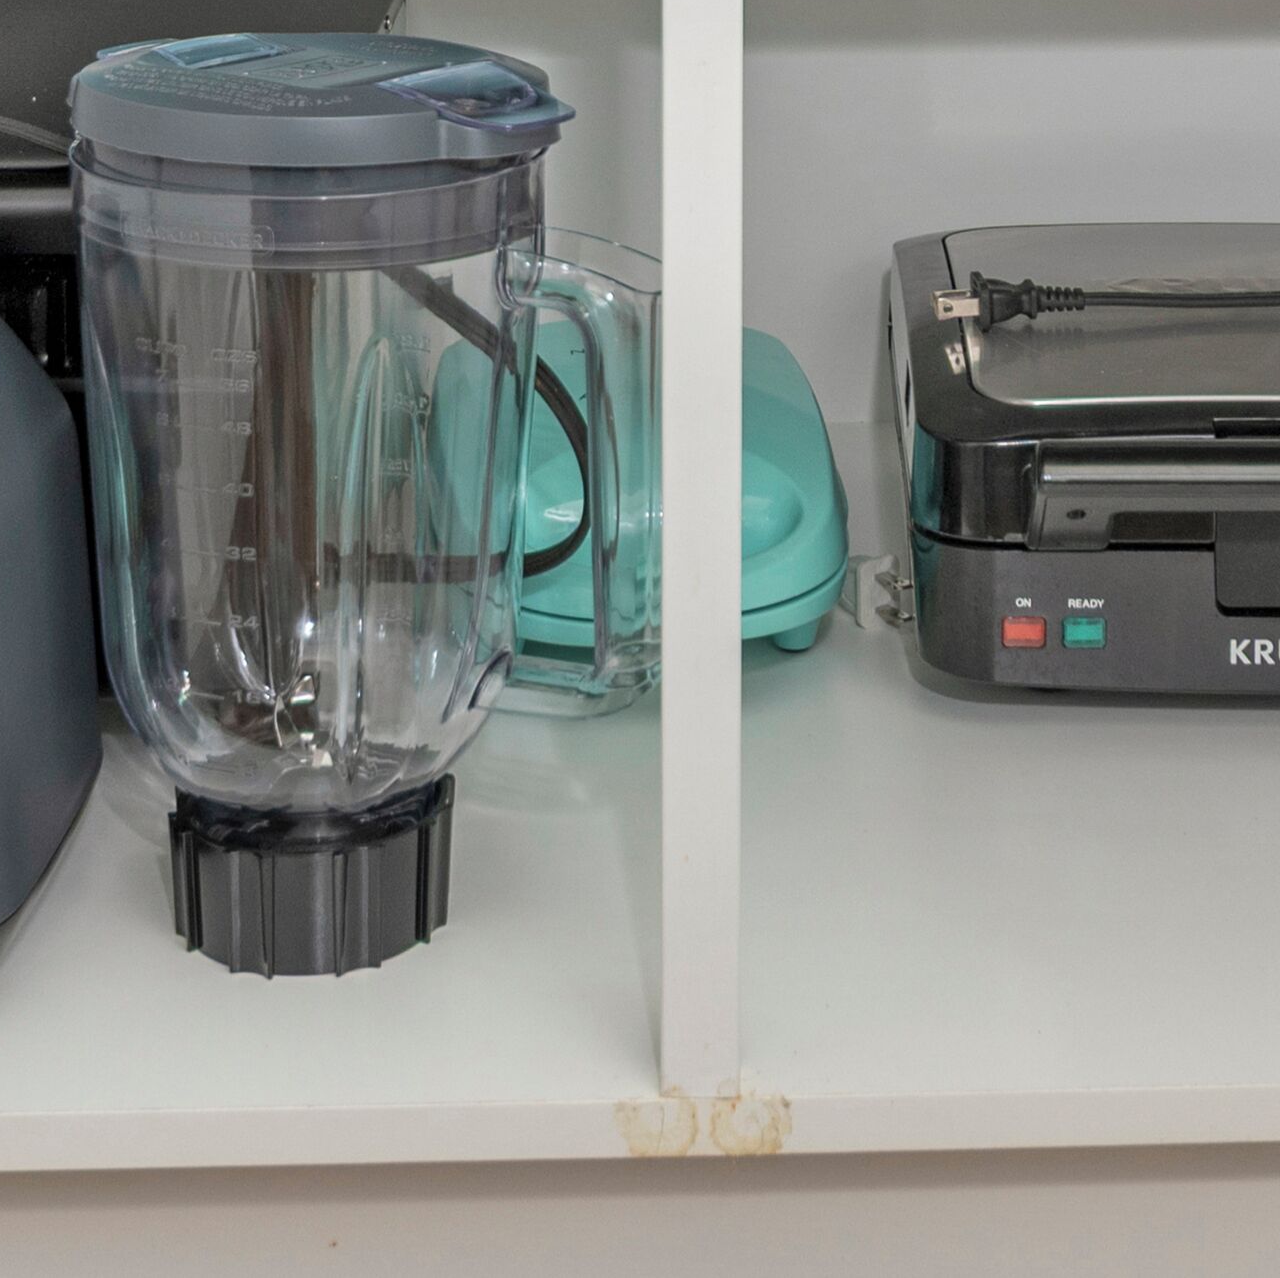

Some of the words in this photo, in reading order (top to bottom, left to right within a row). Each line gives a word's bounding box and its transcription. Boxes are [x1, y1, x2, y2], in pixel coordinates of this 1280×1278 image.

[224, 546, 258, 562] 32
[1015, 598, 1032, 608] ON
[1068, 598, 1105, 609] READY
